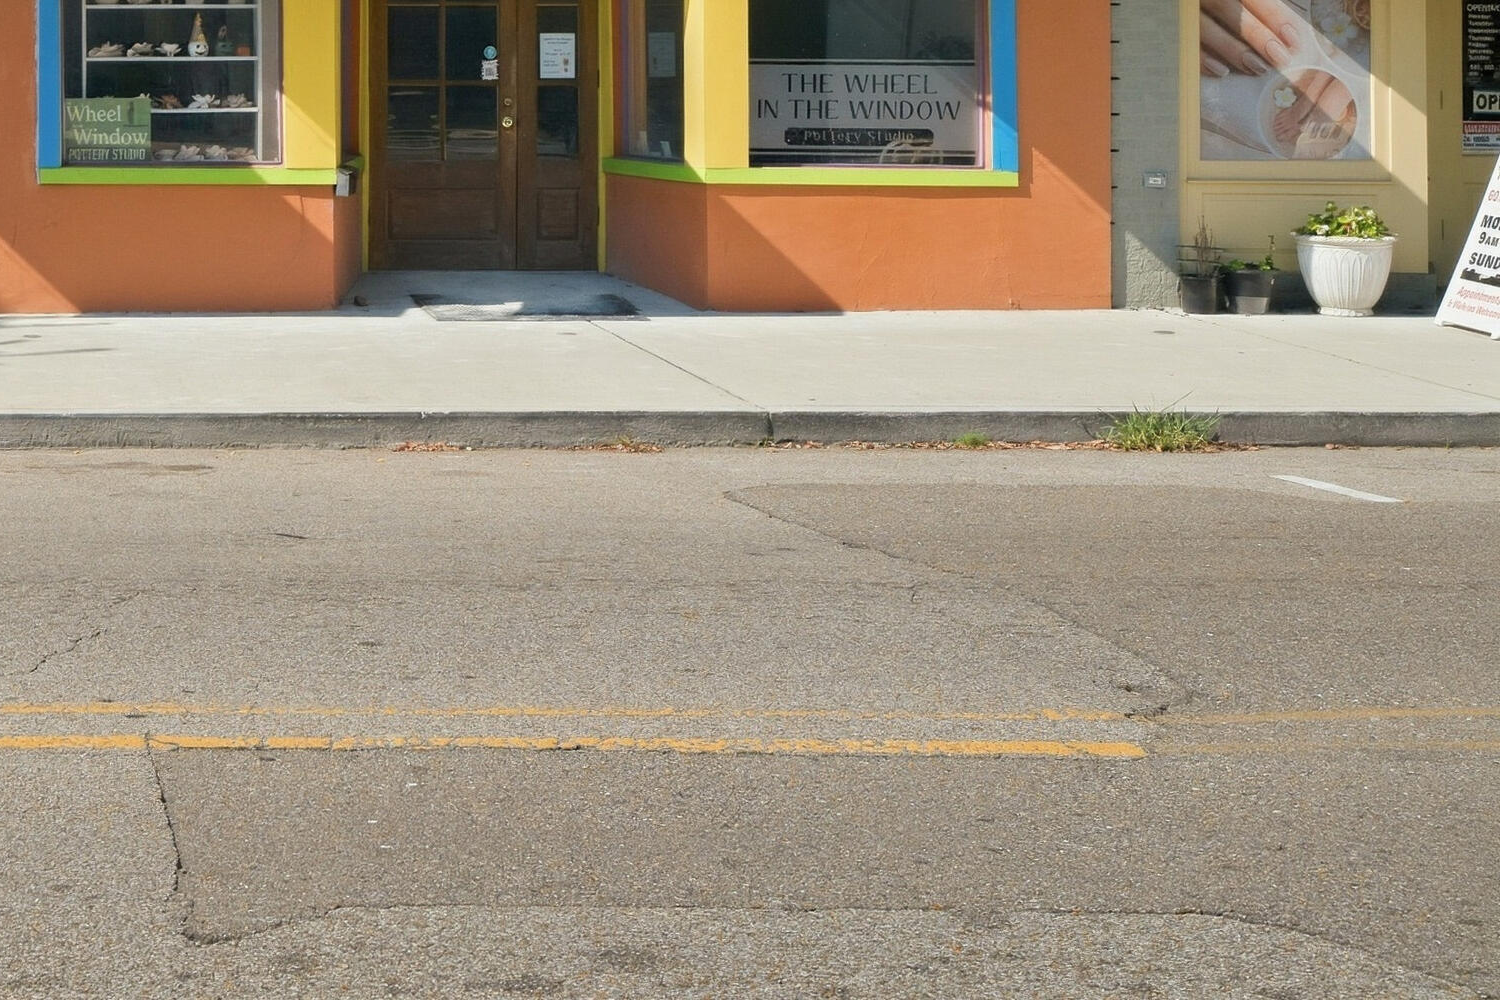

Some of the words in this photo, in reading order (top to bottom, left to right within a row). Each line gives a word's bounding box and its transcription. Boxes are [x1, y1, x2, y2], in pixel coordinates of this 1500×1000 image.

[782, 73, 834, 94] THE
[844, 73, 938, 95] WHEEL
[757, 99, 779, 119] IN
[787, 99, 839, 120] THE
[850, 100, 961, 121] WINDOW
[1476, 94, 1500, 110] OP
[66, 104, 122, 122] Wheel
[73, 127, 148, 145] Window
[68, 148, 110, 161] POTTERY
[112, 148, 146, 161] STUDIO
[1478, 231, 1499, 247] 9AM
